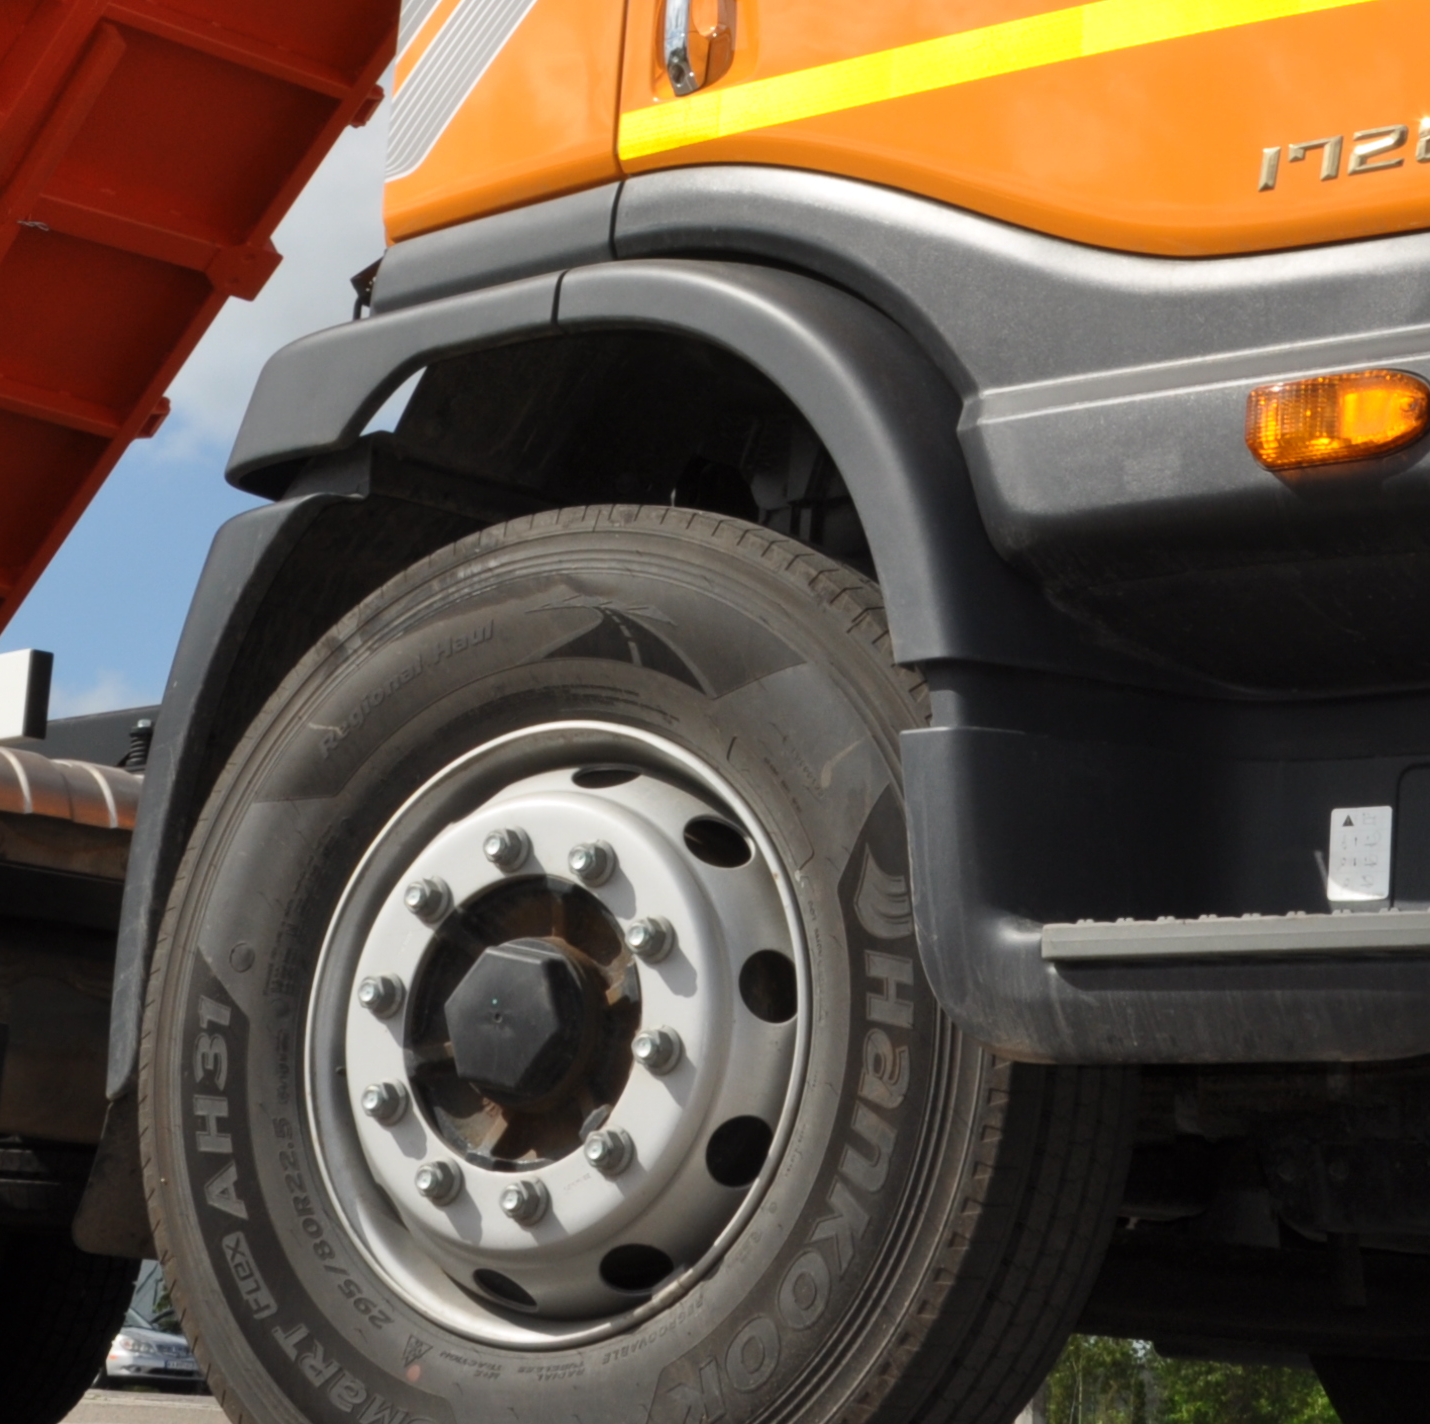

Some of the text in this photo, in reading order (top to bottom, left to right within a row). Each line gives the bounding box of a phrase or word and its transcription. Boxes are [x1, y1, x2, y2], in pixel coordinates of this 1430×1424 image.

[321, 619, 496, 760] Regional Haul
[192, 994, 249, 1220] AH31
[272, 1117, 396, 1330] 295/80R22.5
